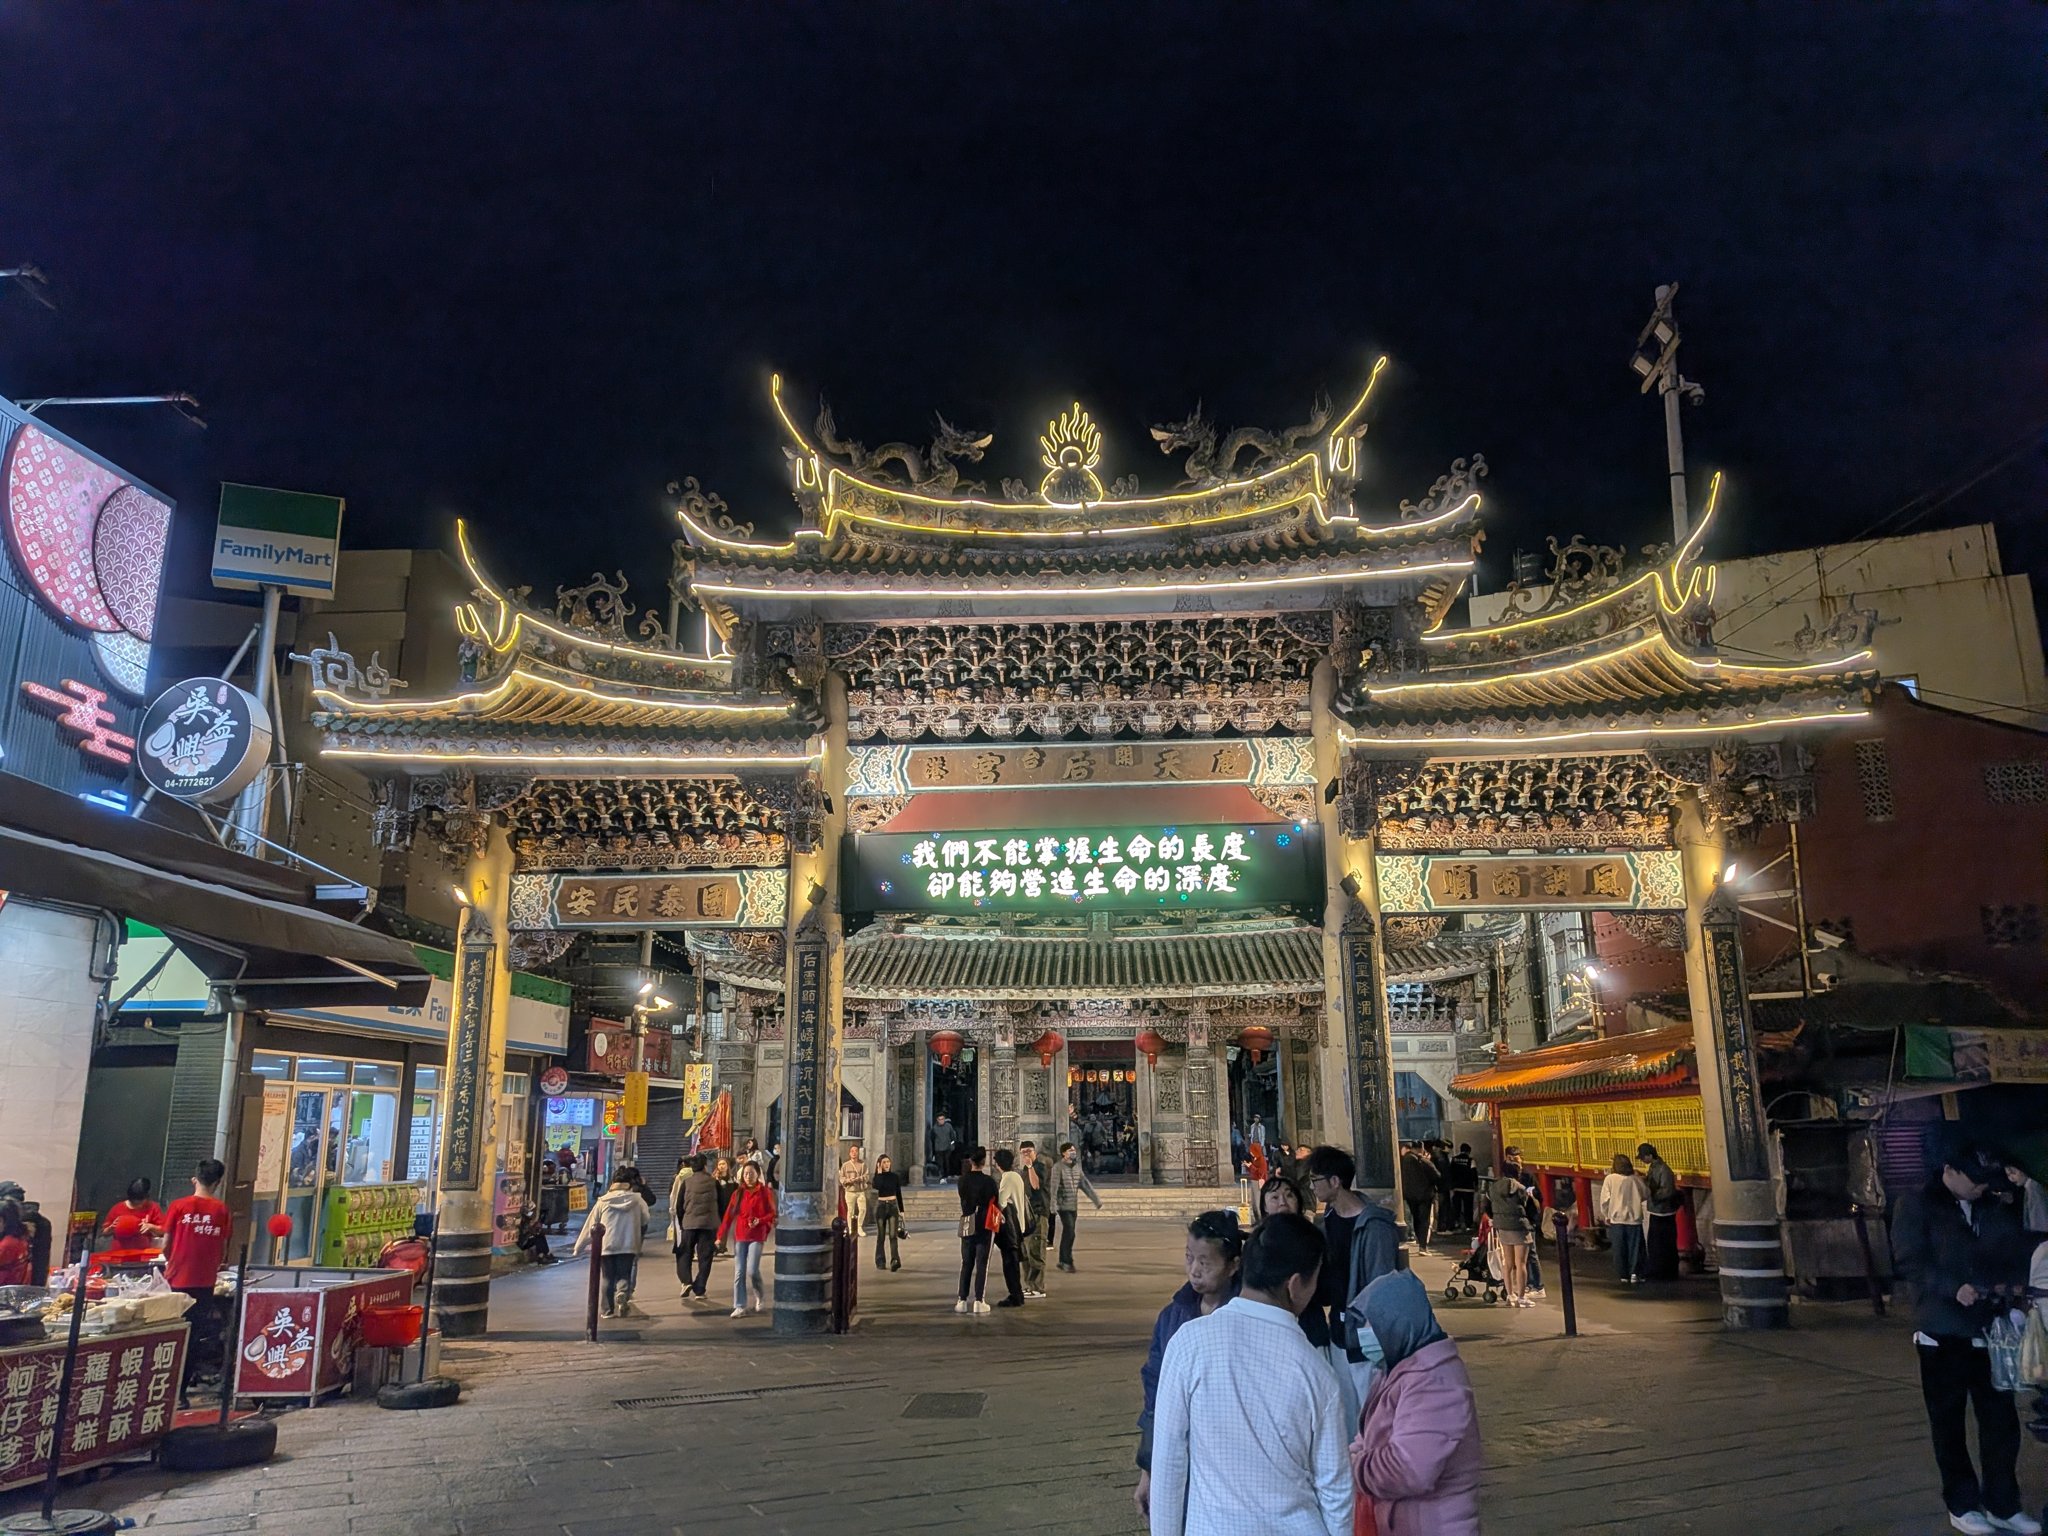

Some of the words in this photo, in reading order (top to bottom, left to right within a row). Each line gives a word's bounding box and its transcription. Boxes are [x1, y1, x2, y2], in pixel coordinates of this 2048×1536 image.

[219, 538, 332, 567] FamilyMart
[164, 776, 215, 789] 04-7772627
[912, 832, 1251, 868] 我們不能掌握生命的長度
[926, 864, 1238, 899] 卻能夠營造生命的深度
[71, 1351, 112, 1452] 蘿蔔糕
[107, 1346, 144, 1443] 蝦猴酥
[140, 1341, 177, 1434] 蚵仔酥
